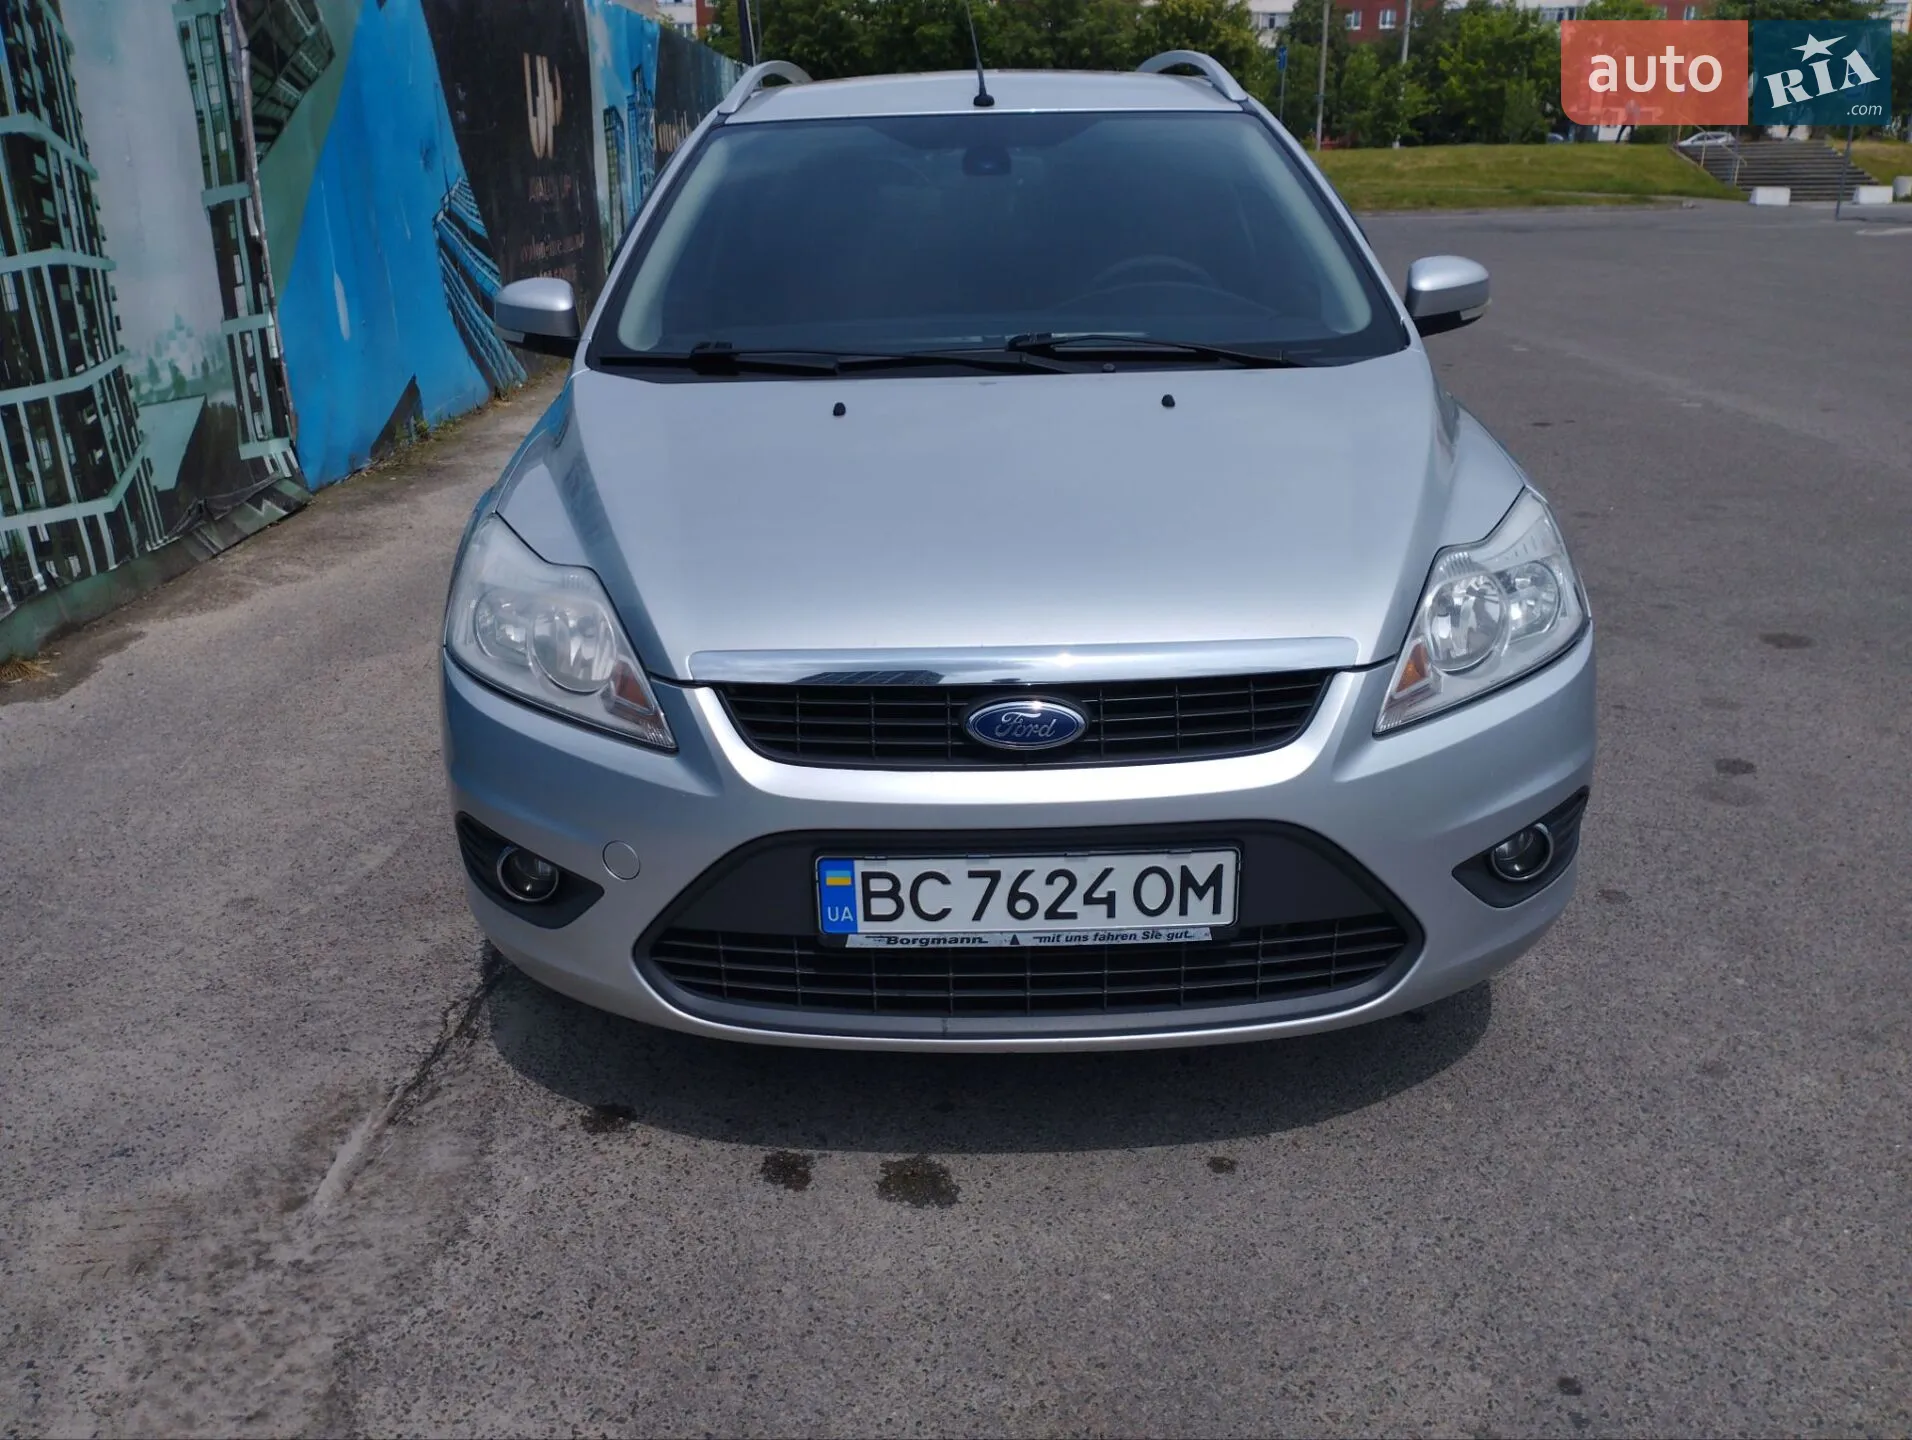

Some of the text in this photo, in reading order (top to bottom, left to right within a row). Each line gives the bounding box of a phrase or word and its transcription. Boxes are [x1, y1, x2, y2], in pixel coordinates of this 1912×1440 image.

[995, 711, 1058, 737] Ford
[861, 863, 1224, 922] BC 7624 OM
[827, 905, 854, 922] UA
[886, 935, 983, 947] Borgmann
[1038, 933, 1061, 944] mit
[1064, 933, 1089, 943] uns
[1092, 931, 1138, 943] fahren
[1141, 930, 1163, 941] Sie
